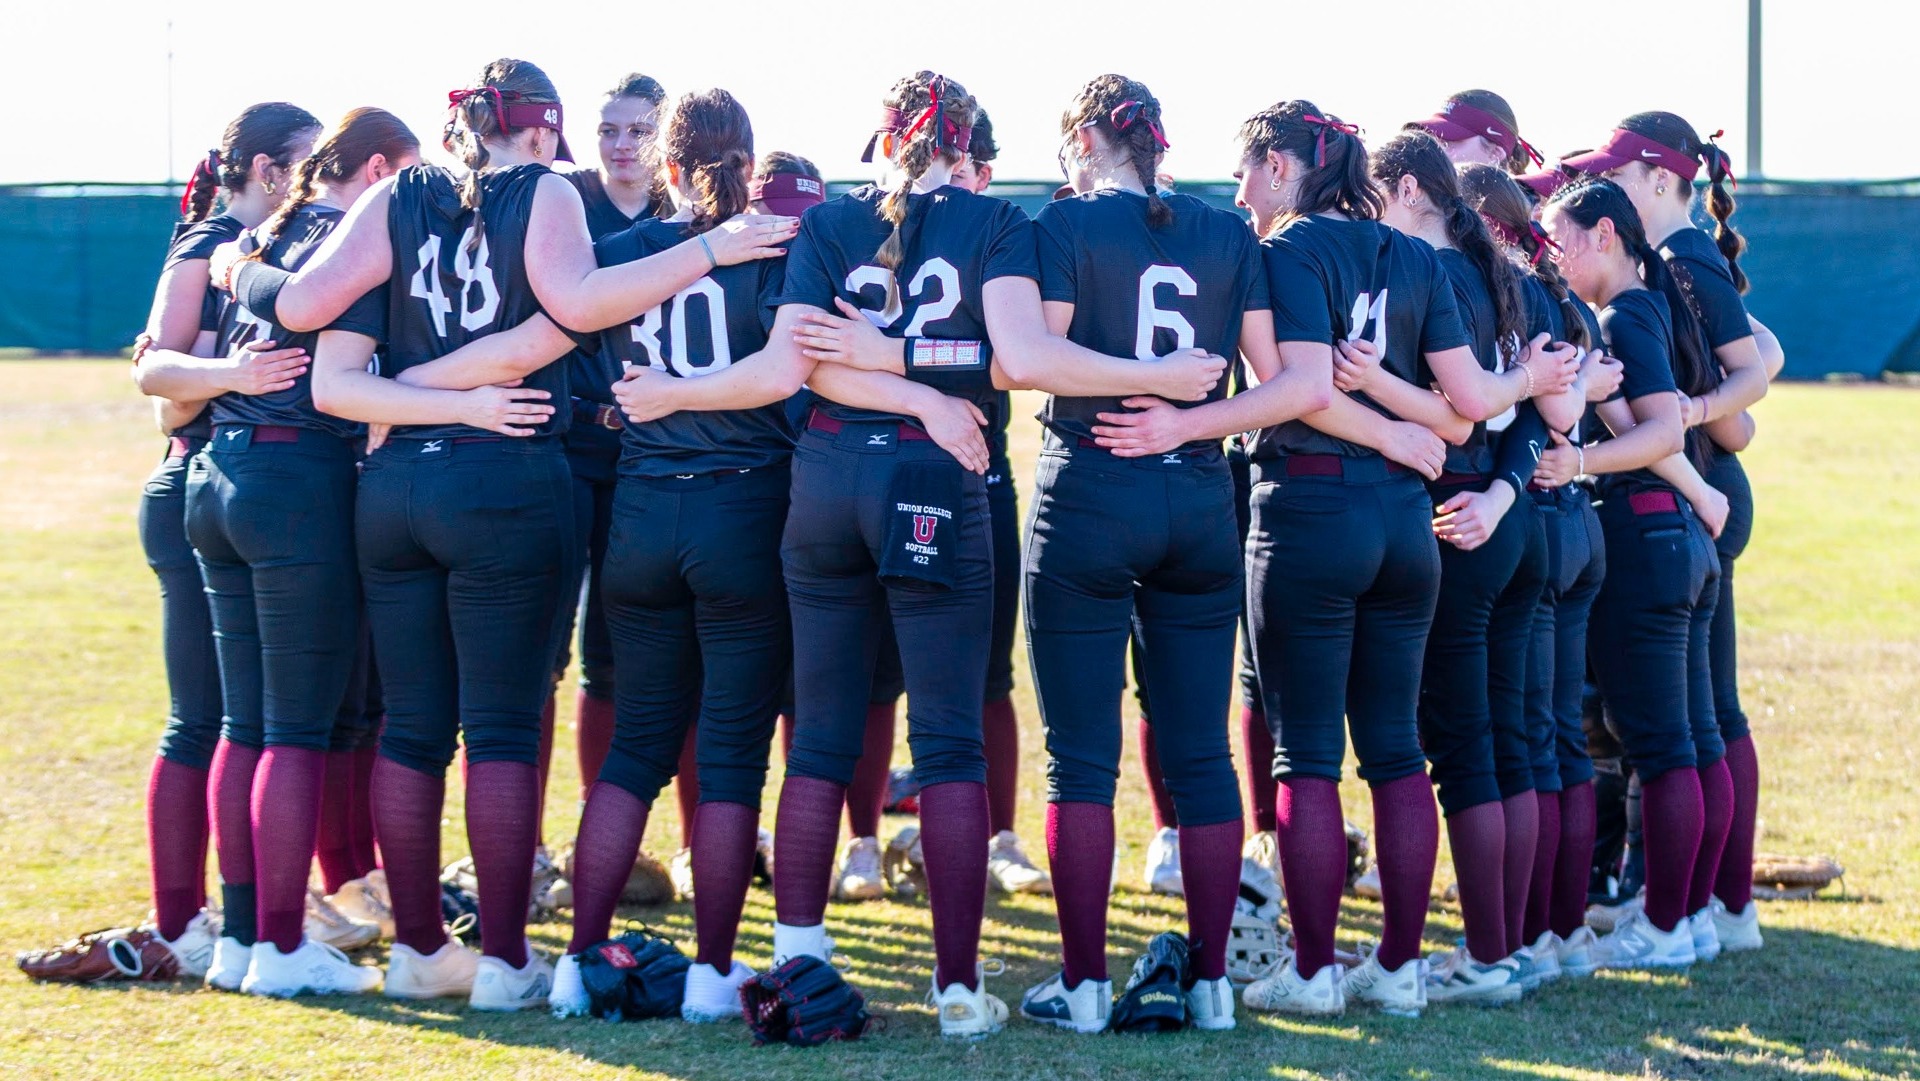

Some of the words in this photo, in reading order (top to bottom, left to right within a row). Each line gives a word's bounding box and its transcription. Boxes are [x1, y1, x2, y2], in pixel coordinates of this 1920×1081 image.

[543, 108, 558, 125] 48
[410, 226, 500, 337] 48
[845, 256, 961, 338] 22
[1135, 264, 1197, 362] 6
[622, 275, 731, 378] 30
[897, 502, 922, 513] UNION
[923, 505, 952, 519] COLLEGE
[913, 514, 938, 544] U
[905, 542, 938, 555] SOFTBALL
[913, 554, 929, 565] #22
[1140, 991, 1178, 1005] Wilson
